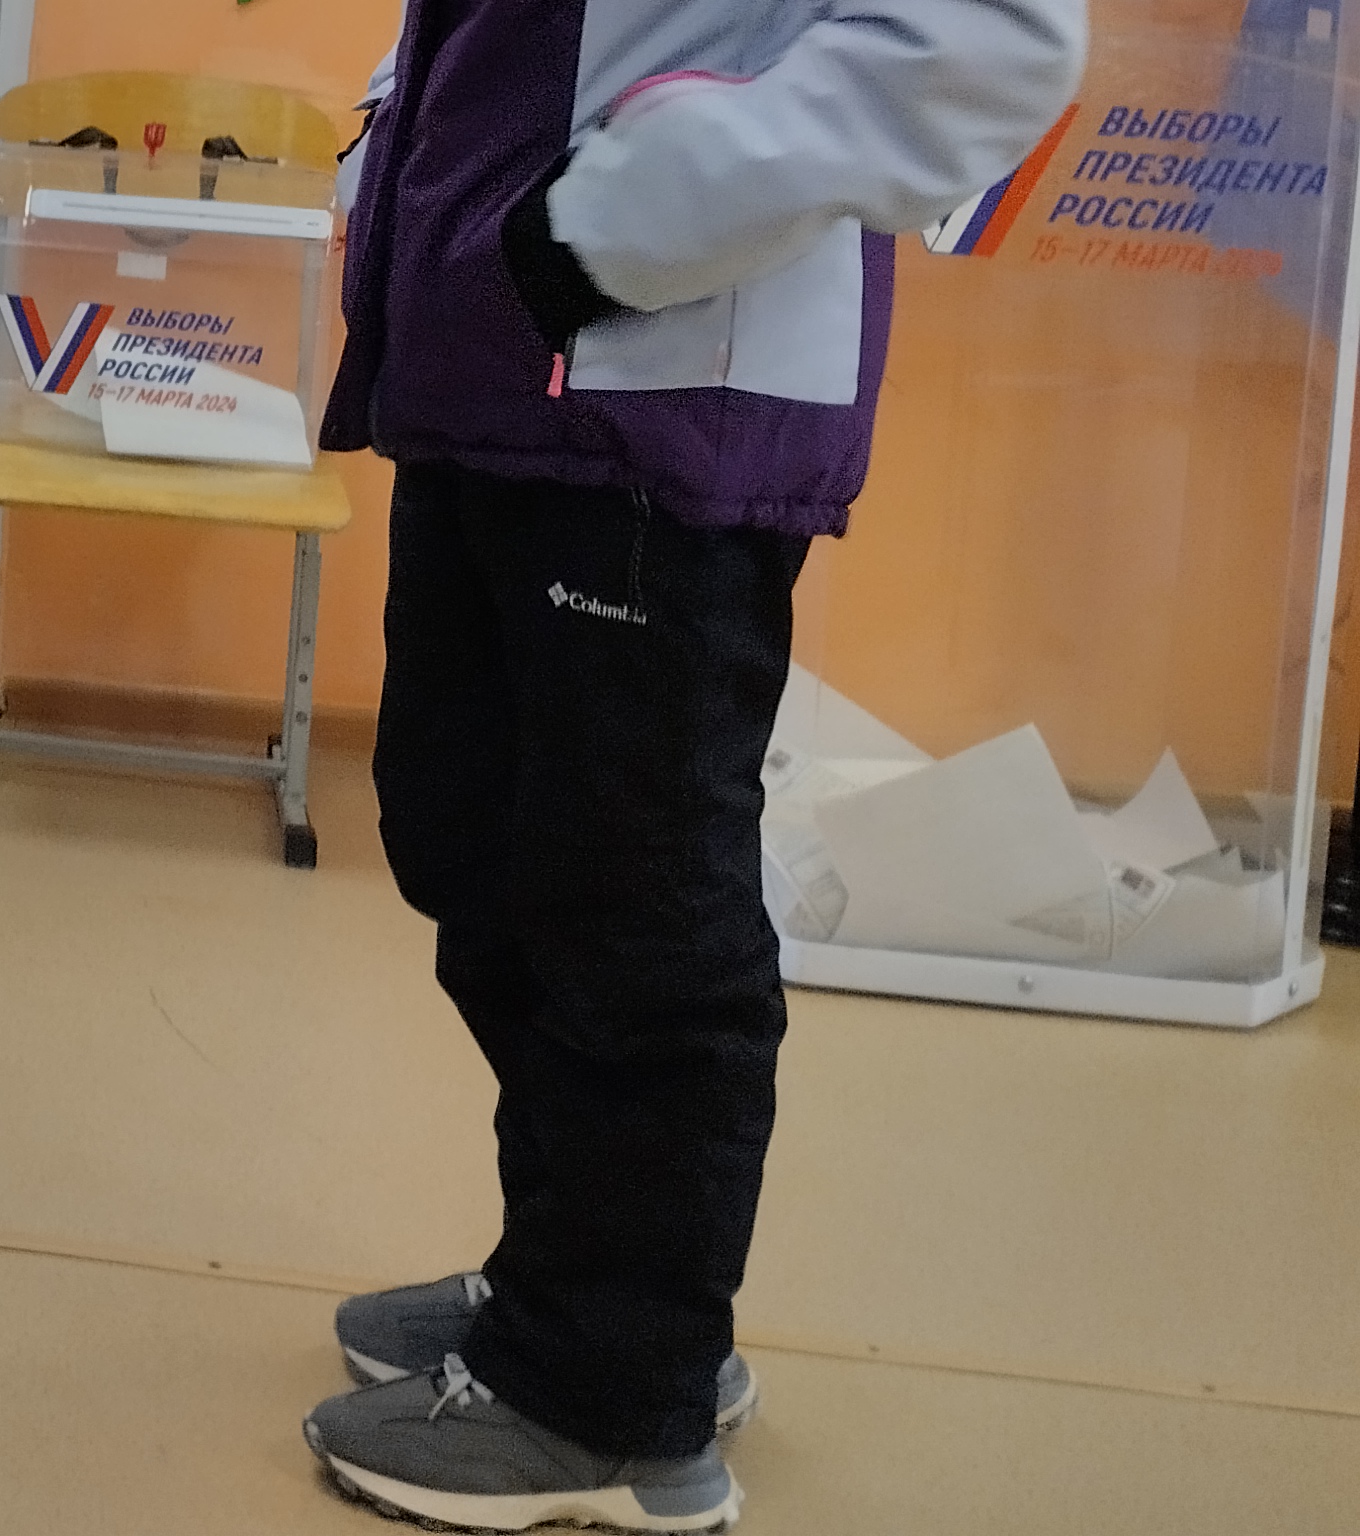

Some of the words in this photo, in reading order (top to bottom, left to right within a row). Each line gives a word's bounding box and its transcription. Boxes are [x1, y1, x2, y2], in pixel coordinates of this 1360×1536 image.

[1097, 105, 1282, 148] ВЫБОРЫ
[1072, 150, 1328, 197] ПРЕЗИДЕНТА
[1048, 193, 1216, 234] РОССИИ
[126, 307, 236, 336] ВЫБОРЫ
[112, 333, 264, 367] ПРЕЗИДЕНТА
[98, 358, 196, 386] РОССИИ
[135, 386, 194, 410] МАРТА
